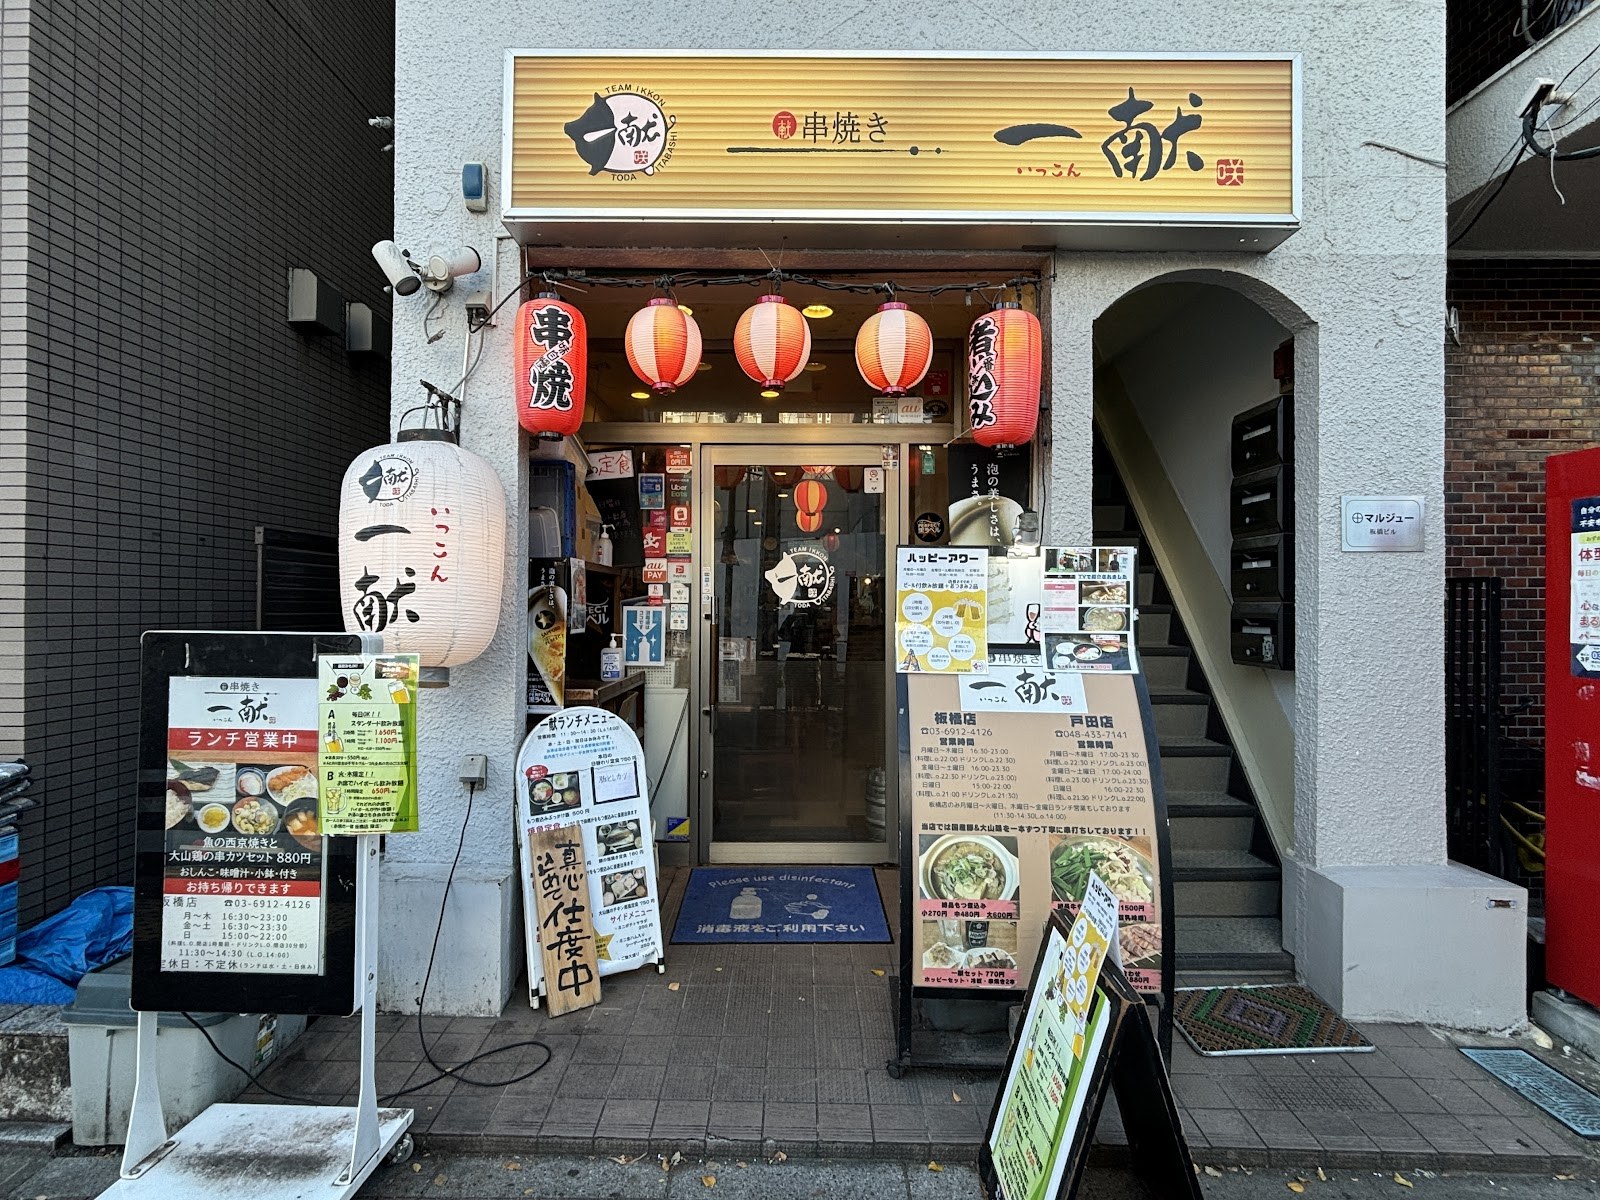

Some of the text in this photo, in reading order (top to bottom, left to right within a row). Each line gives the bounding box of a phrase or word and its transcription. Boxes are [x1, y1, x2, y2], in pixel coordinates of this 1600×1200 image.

[605, 84, 667, 107] TEAM IKKON
[802, 111, 888, 144] 串焼き
[993, 87, 1204, 181] 一献
[655, 131, 677, 172] ITABASHI
[1017, 163, 1081, 178] いっこん
[611, 173, 637, 182] TODA
[902, 405, 921, 413] au
[598, 453, 631, 476] 定食
[971, 464, 982, 506] うまさ。
[987, 463, 1000, 542] 泡の美しさは、
[1364, 513, 1414, 523] マルジュー
[430, 507, 450, 582] いっこん
[789, 546, 828, 562] TEAM IKKON
[907, 553, 979, 563] ハッピーアワー
[353, 524, 420, 633] 一献
[821, 576, 835, 602] ITABASHI
[229, 681, 260, 692] 串焼き
[328, 709, 335, 719] A
[934, 712, 977, 726] 板橋店
[540, 713, 616, 731] 一献ランチメニュー
[1070, 715, 1114, 729] 戸田店
[929, 728, 993, 736] 03-6912-4126
[1063, 730, 1128, 739] 048-433-7141
[187, 731, 298, 749] ランチ営業中
[939, 737, 975, 746] 営業時間
[1077, 740, 1114, 749] 営業時間
[327, 771, 334, 781] B
[371, 787, 390, 795] 650円
[203, 836, 278, 849] 魚の西京焼きと
[168, 851, 311, 865] 大山鶏の串カツセット 880円
[555, 839, 584, 892] 真心
[180, 867, 298, 880] おしんこ・味噌汁・小鉢・付き
[186, 881, 292, 894] お持ち帰りできます
[708, 874, 856, 889] Please use disinfectant
[234, 899, 311, 909] 03-6912-4126
[183, 912, 288, 922] 月〜木 16:30〜23:00
[610, 909, 653, 924] サイドメニュー
[986, 911, 1013, 919] 大600円
[183, 921, 288, 931] 金〜土 16:30〜23:30
[696, 923, 865, 934] 消毒液をご利用下さい
[183, 931, 288, 941] 日 15:00〜22:00
[179, 949, 243, 958] 11:30〜14:30
[543, 897, 593, 997] 仕度中
